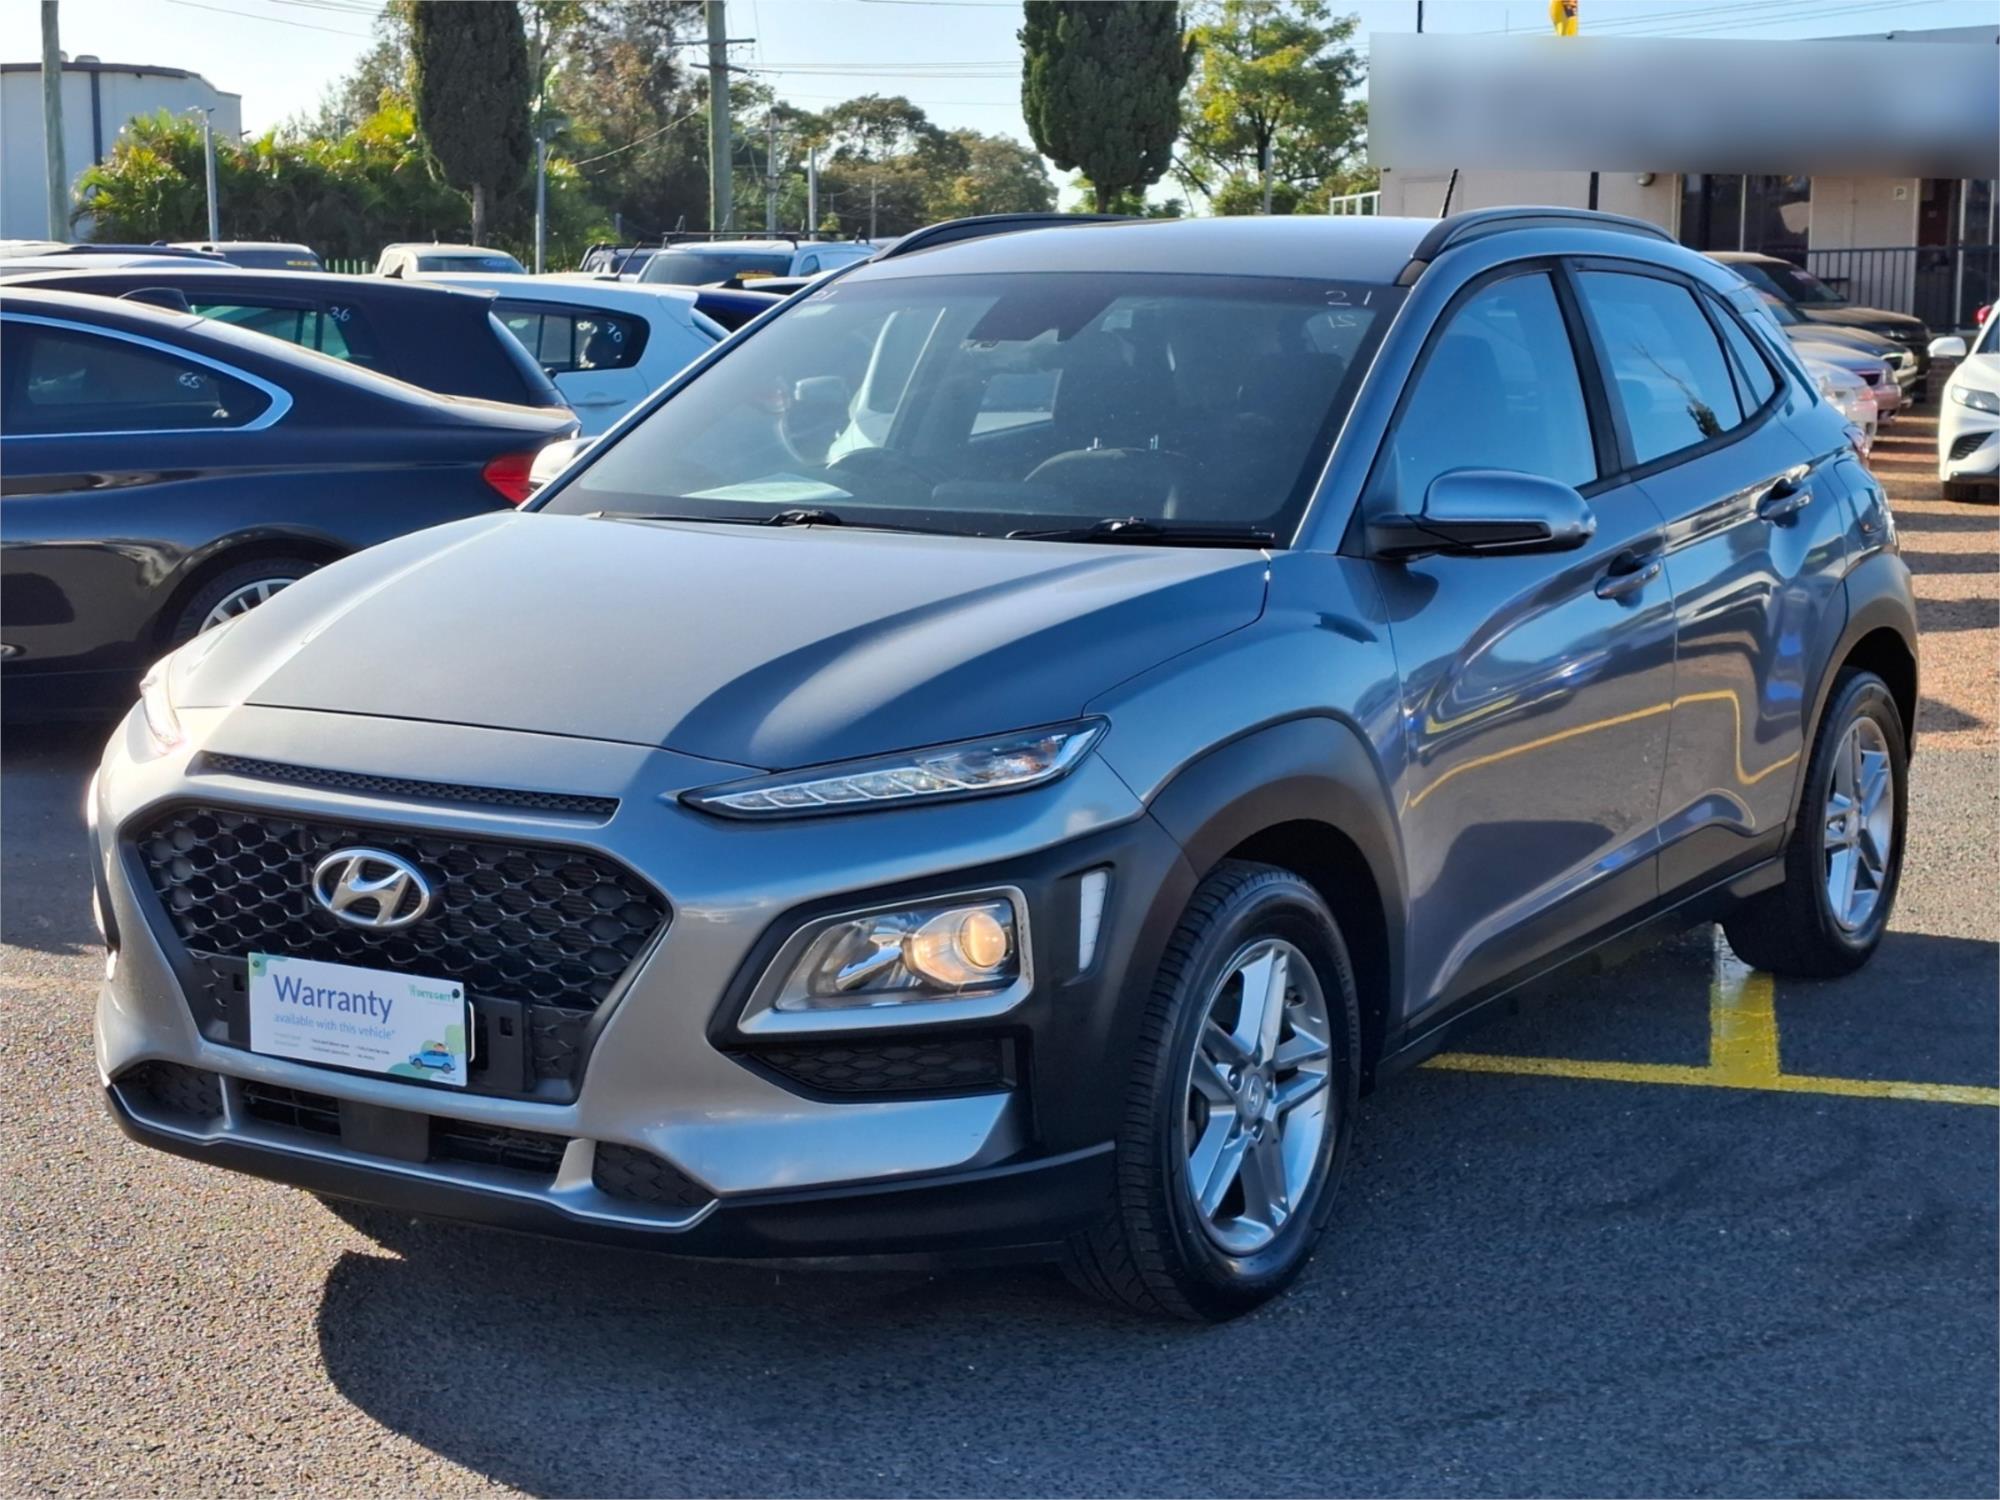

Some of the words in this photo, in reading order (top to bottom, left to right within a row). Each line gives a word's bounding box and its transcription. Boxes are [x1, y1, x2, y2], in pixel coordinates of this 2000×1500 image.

[1325, 289, 1372, 307] 21
[330, 305, 351, 322] 36
[272, 973, 393, 1024] Warranty
[273, 1013, 314, 1028] available
[316, 1018, 338, 1031] with
[340, 1022, 357, 1035] this
